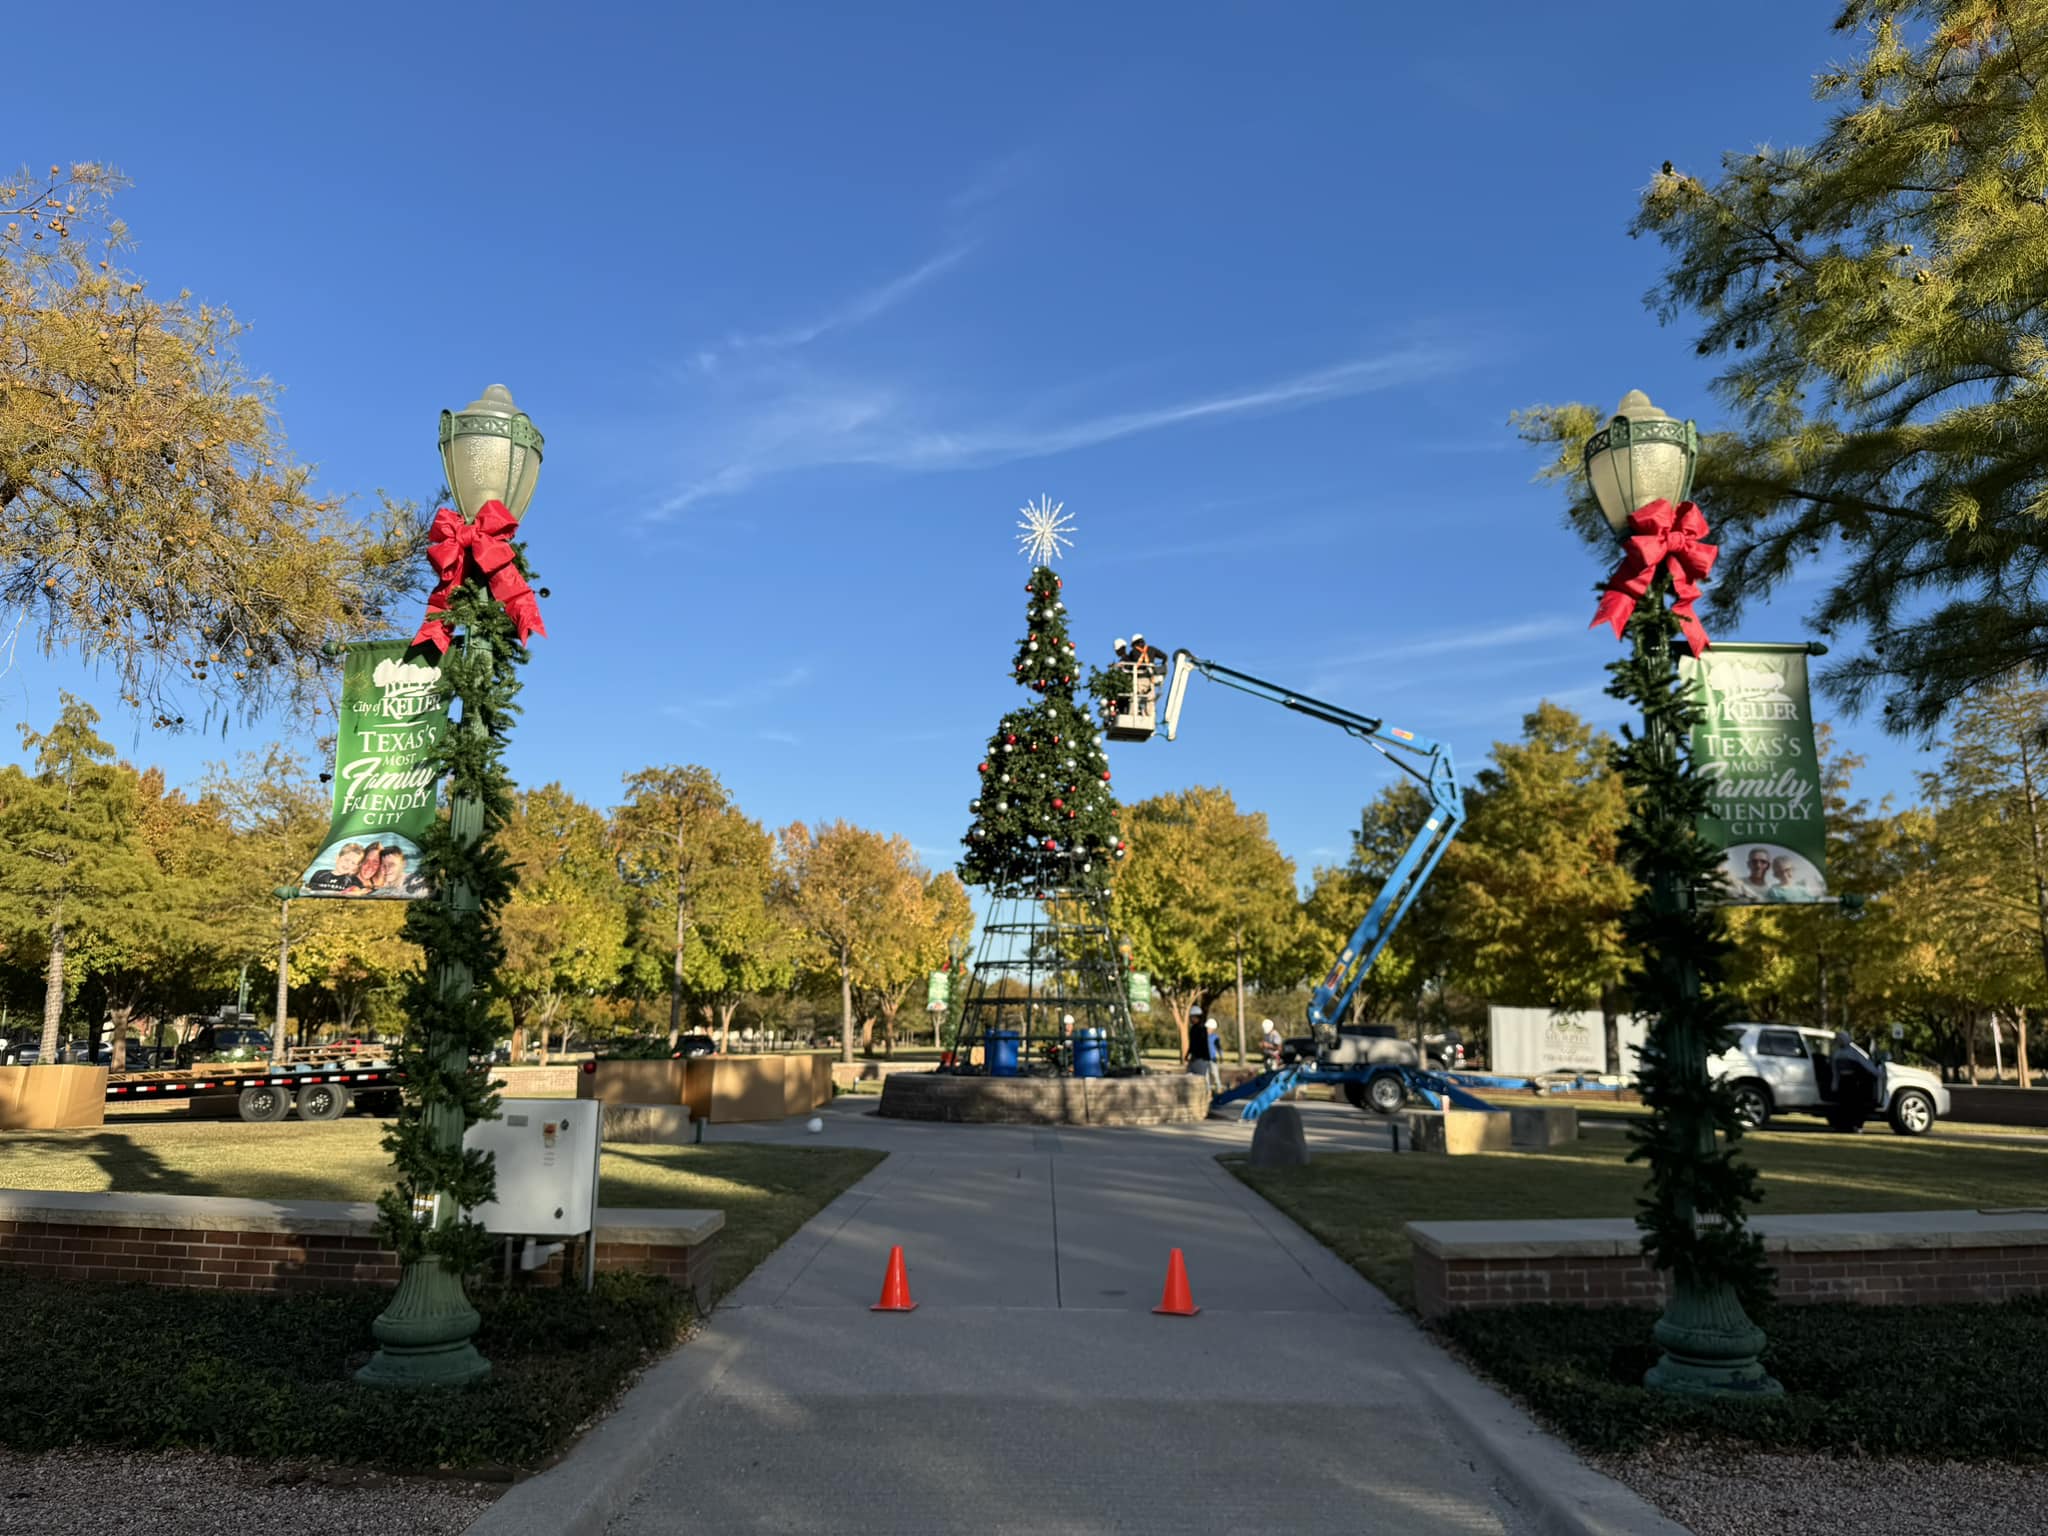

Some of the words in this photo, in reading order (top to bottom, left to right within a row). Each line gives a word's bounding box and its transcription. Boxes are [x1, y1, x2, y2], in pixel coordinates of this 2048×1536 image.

[353, 700, 372, 716] City
[373, 698, 383, 716] of
[382, 694, 442, 720] KELLER
[1720, 702, 1799, 723] KELLER
[357, 724, 437, 753] TEXAS'S
[1702, 733, 1802, 757] TEXAS'S
[382, 753, 417, 767] MOST
[1730, 759, 1777, 773] MOST
[342, 757, 436, 798] Family
[341, 789, 432, 815] FRIENDLY
[363, 811, 404, 825] CITY
[1731, 821, 1780, 836] CITY
